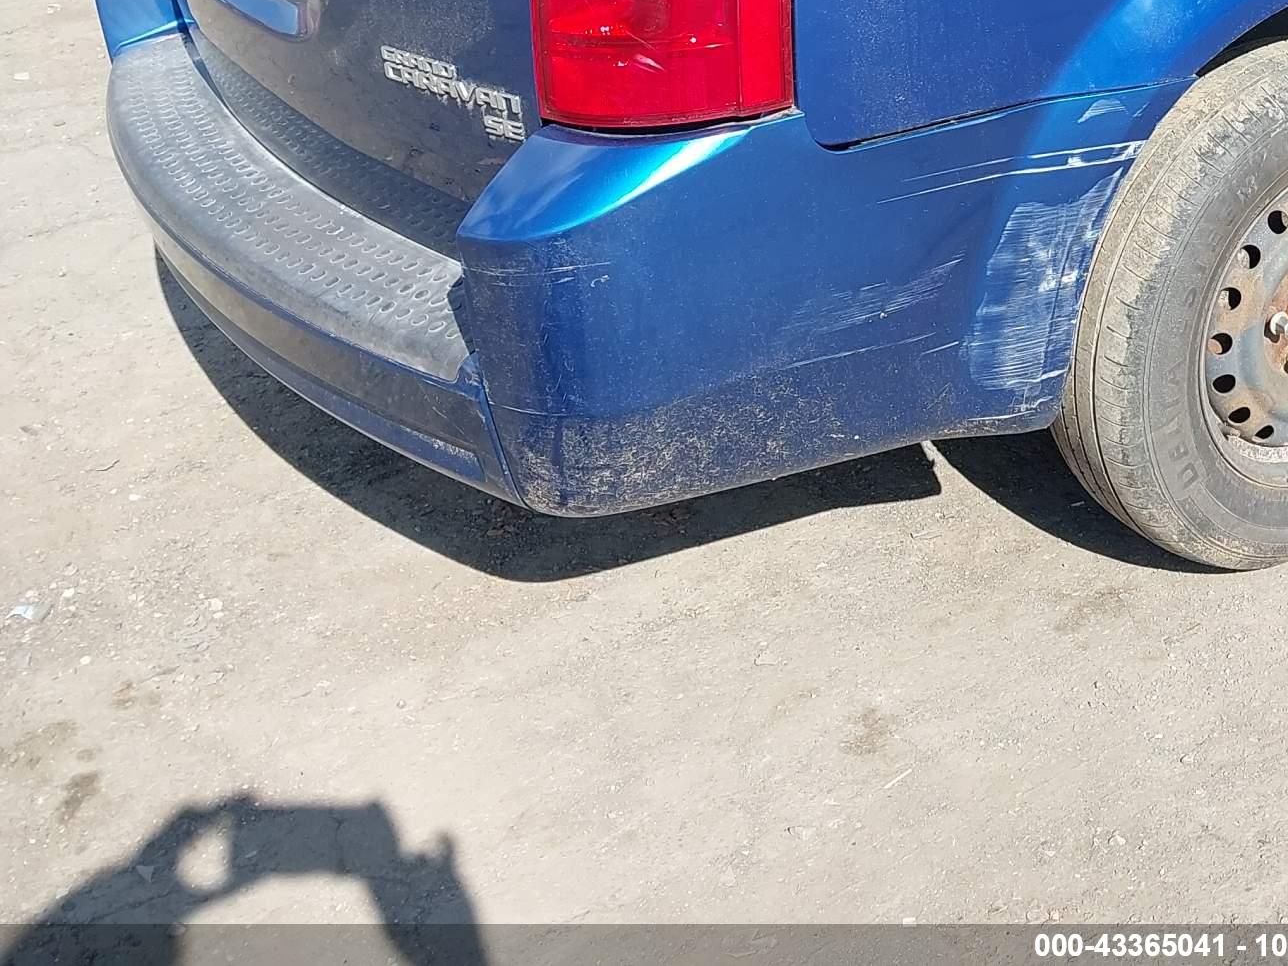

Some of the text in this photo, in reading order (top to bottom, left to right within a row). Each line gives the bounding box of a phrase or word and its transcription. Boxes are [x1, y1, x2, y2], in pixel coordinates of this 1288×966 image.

[380, 45, 457, 78] GRAND
[383, 61, 521, 114] CARAVAN
[485, 115, 525, 142] SE
